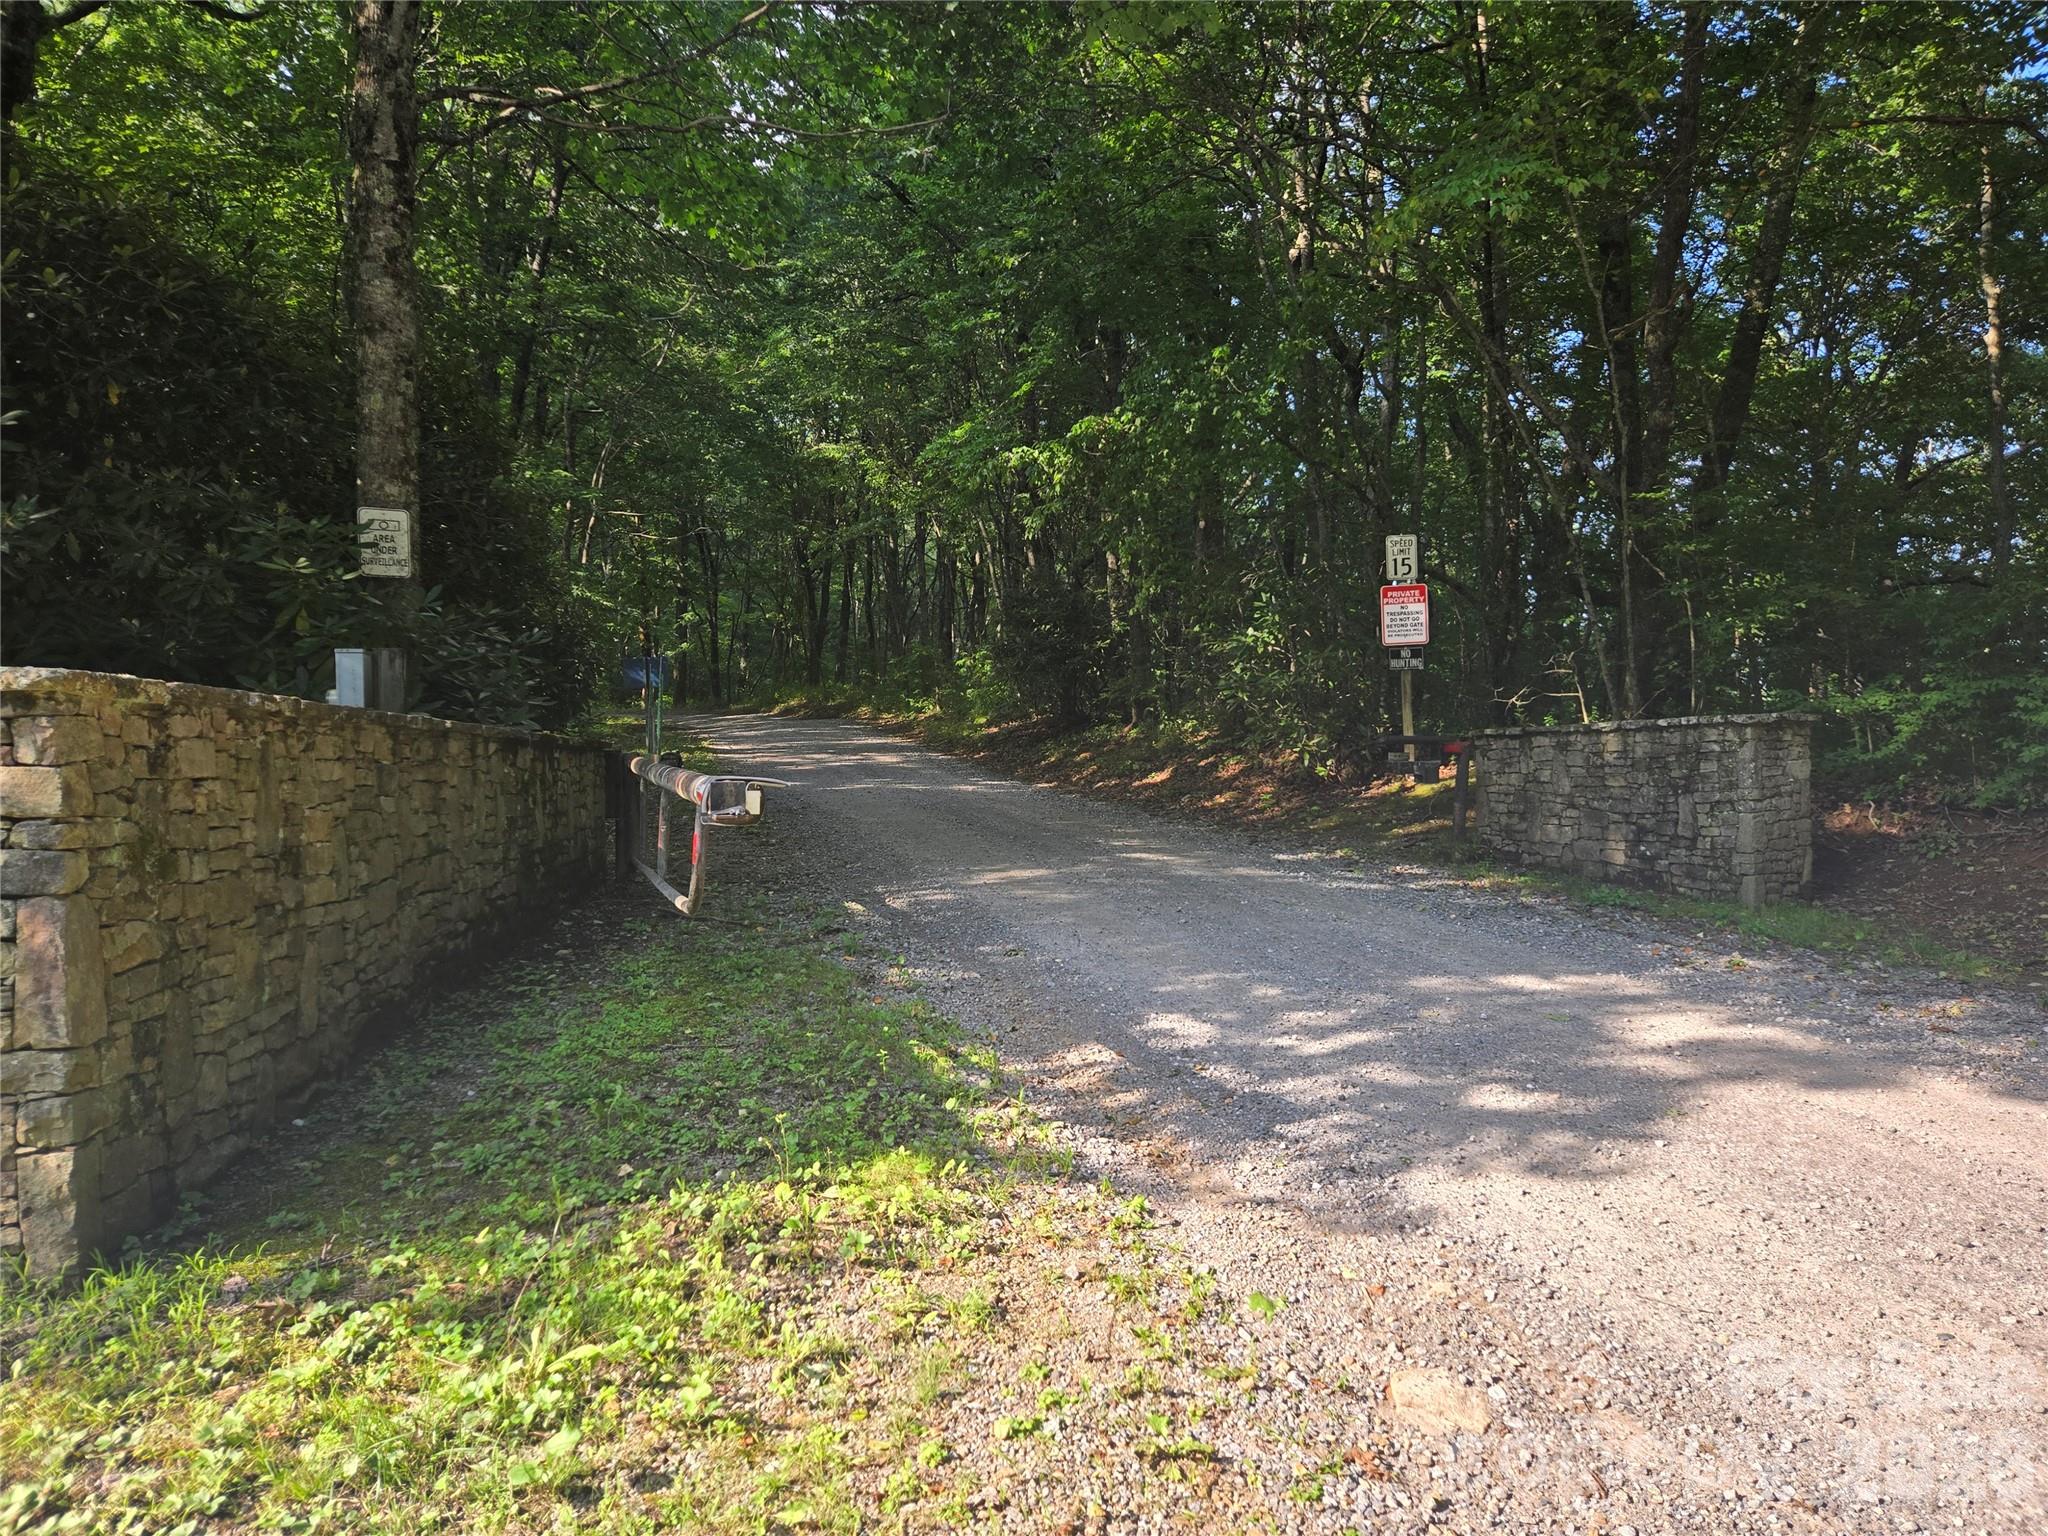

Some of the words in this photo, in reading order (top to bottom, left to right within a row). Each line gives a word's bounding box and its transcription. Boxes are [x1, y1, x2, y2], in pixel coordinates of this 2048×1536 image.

[373, 534, 396, 543] AREA
[1390, 539, 1413, 548] SPEED
[371, 546, 398, 555] UNDER
[1392, 548, 1411, 556] LIMIT
[1391, 557, 1412, 577] 15
[1387, 590, 1420, 598] PRIVATE
[1384, 596, 1425, 604] PROPERTY
[1400, 649, 1411, 658] NO
[1391, 658, 1423, 668] HUNTING
